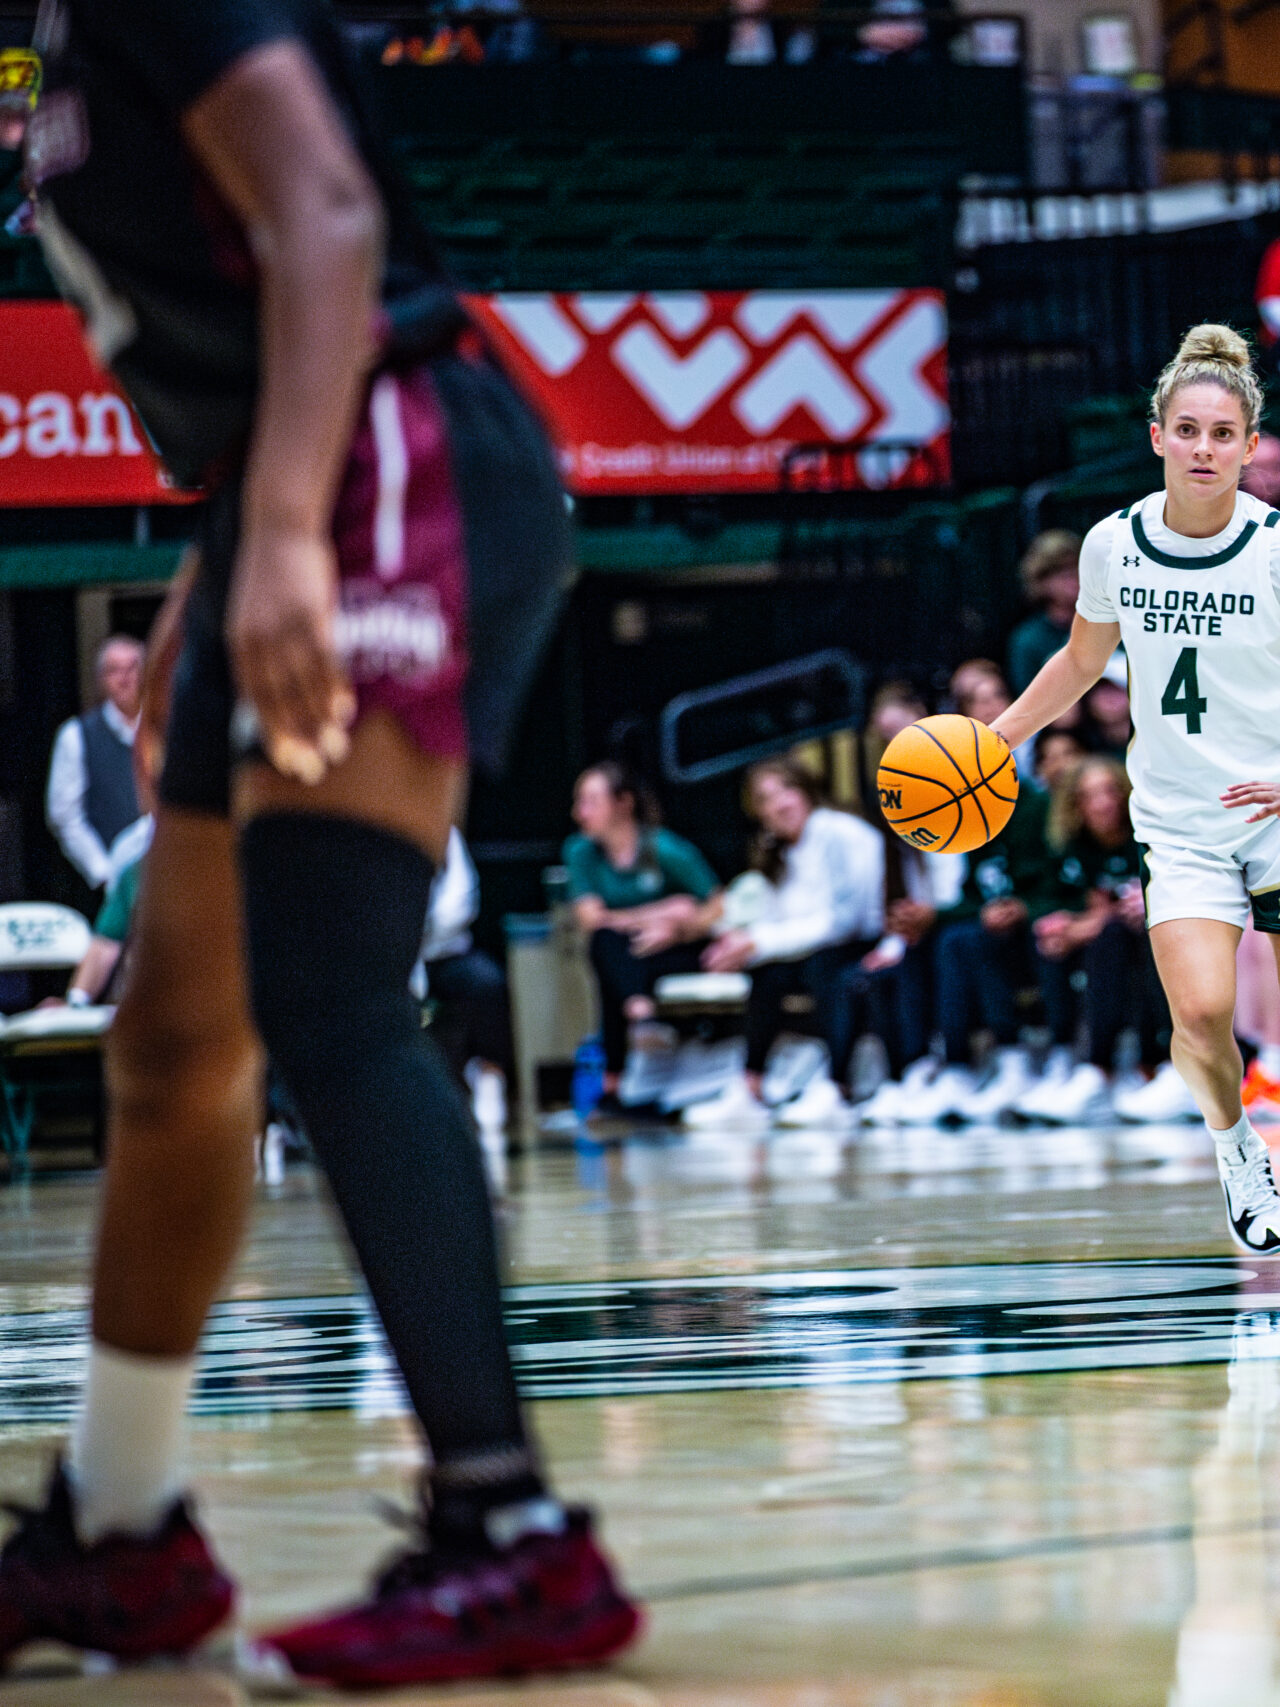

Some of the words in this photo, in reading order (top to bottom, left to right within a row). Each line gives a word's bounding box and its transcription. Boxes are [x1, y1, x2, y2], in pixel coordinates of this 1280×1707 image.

[1120, 587, 1255, 615] COLORADO
[1143, 612, 1222, 636] STATE
[1161, 647, 1208, 735] 4
